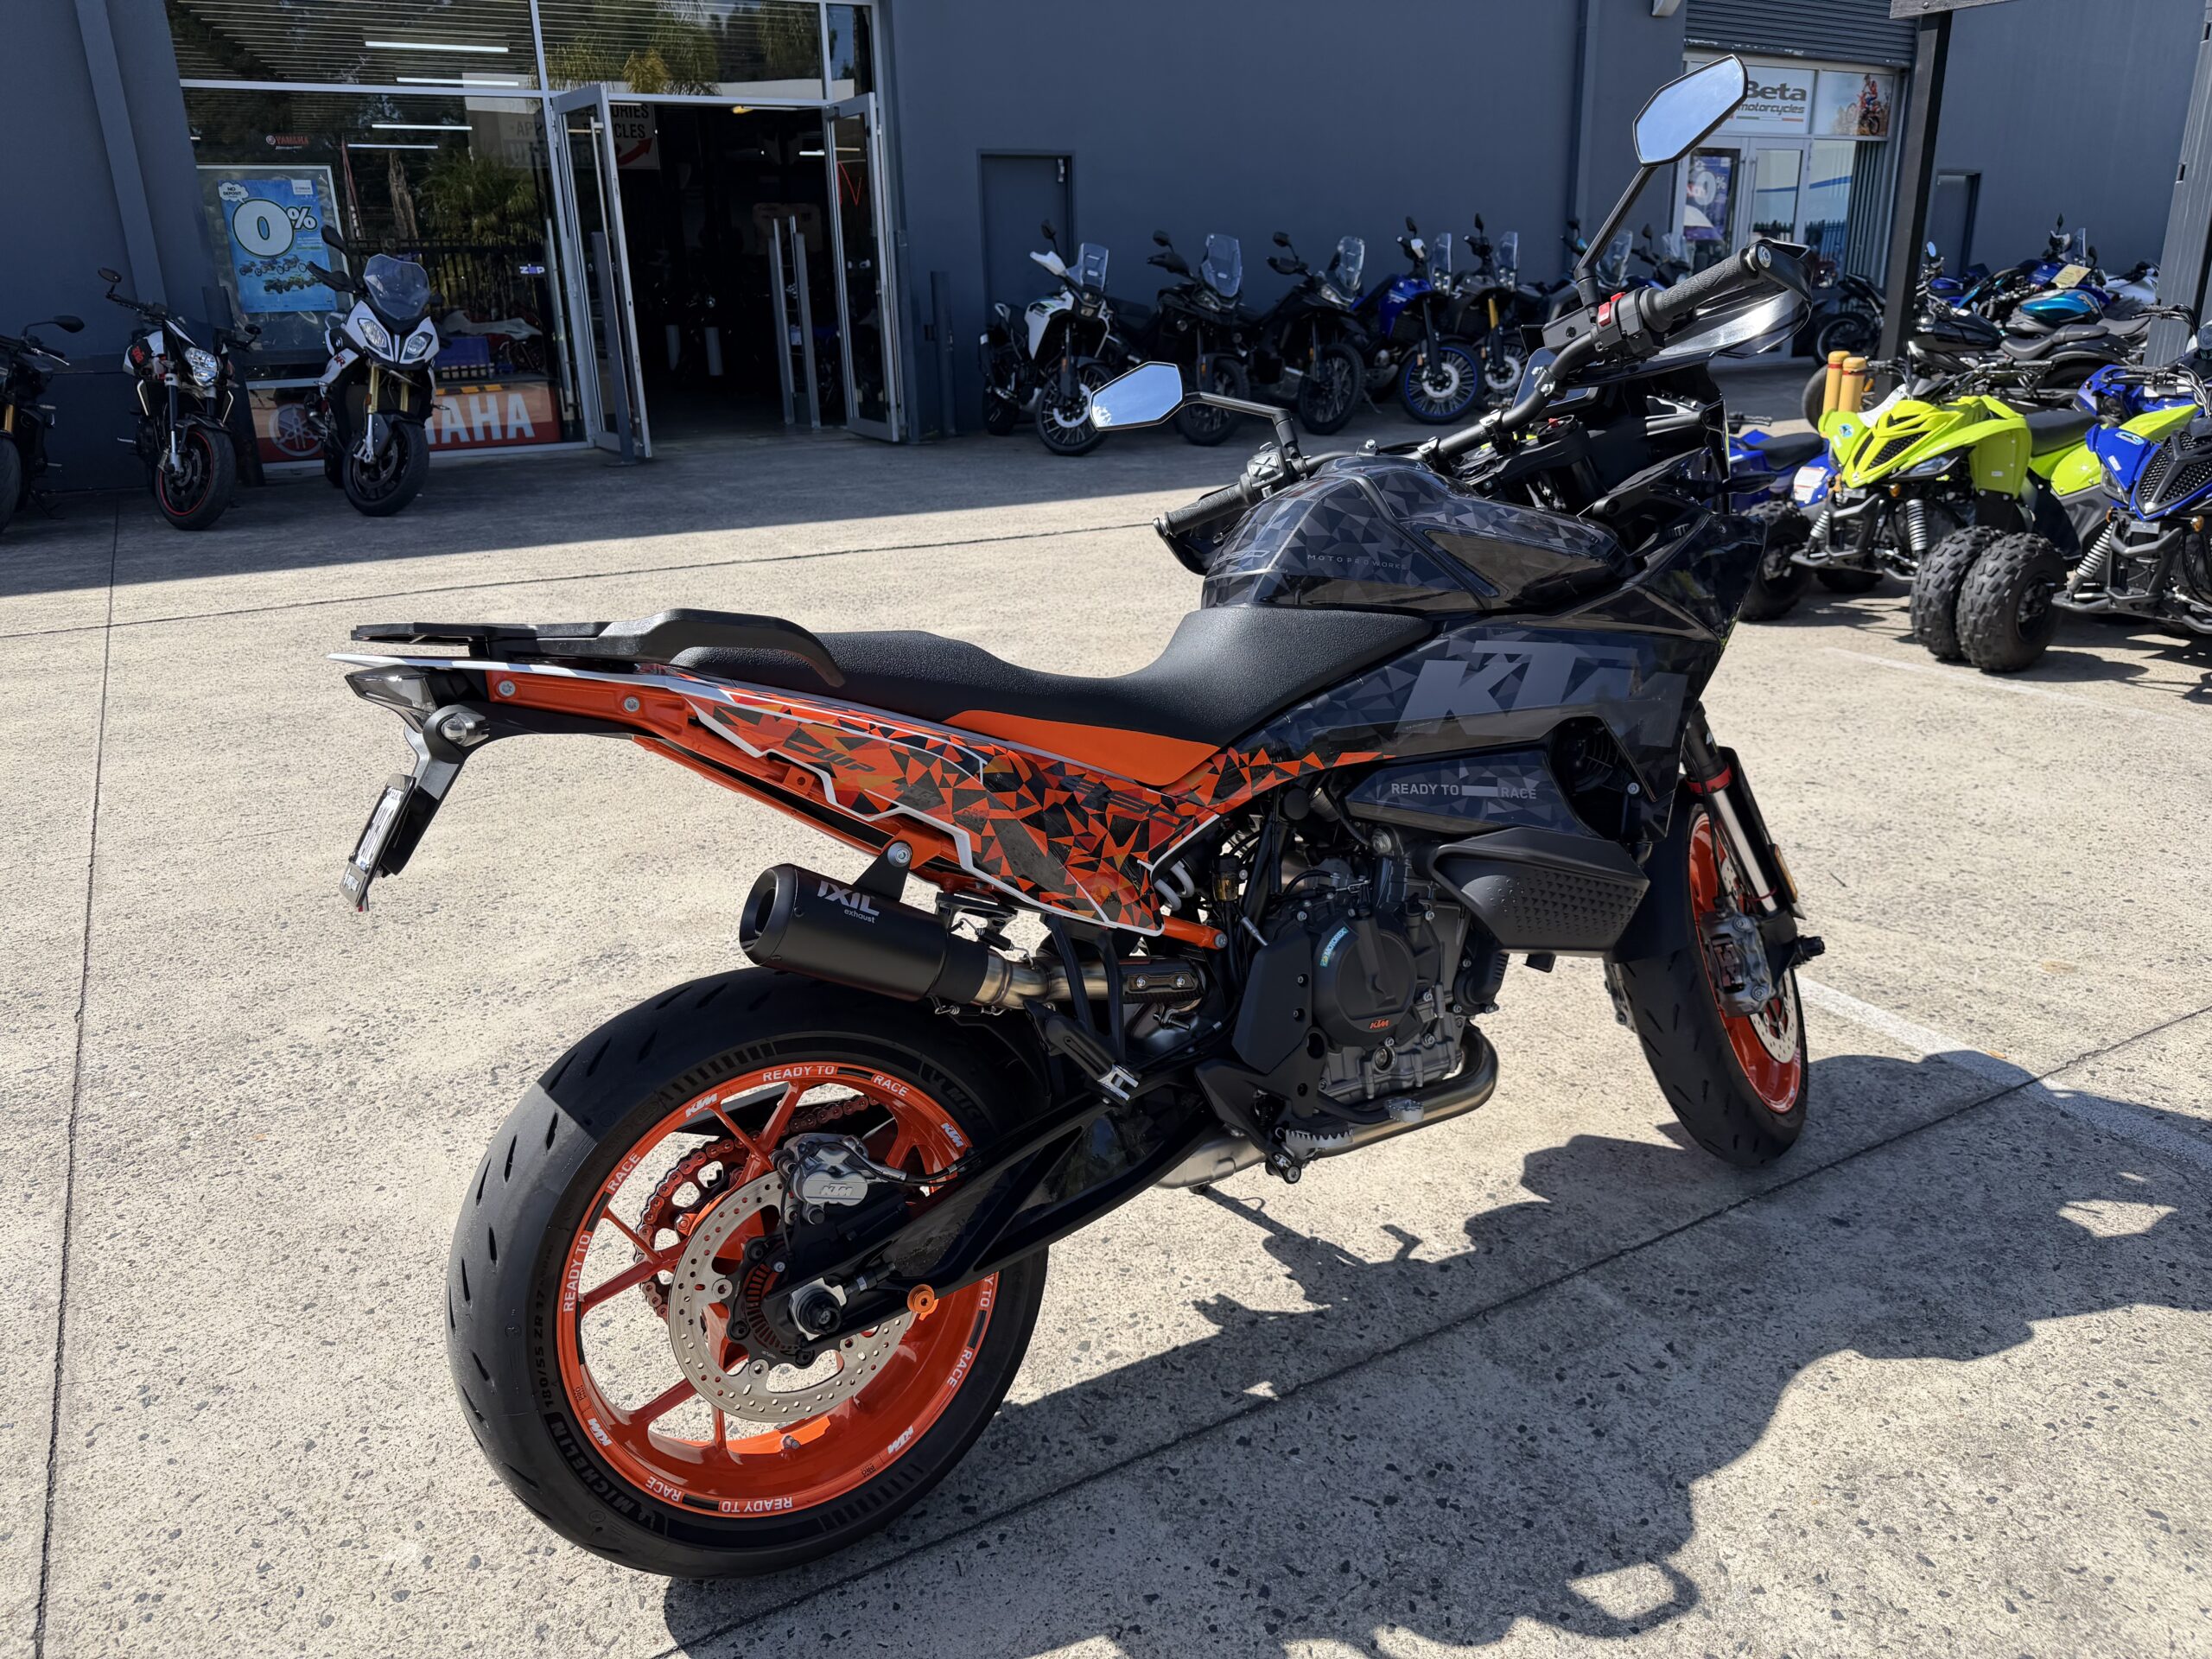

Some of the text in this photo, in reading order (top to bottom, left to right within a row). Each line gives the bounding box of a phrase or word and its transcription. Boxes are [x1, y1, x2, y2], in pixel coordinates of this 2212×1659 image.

[1746, 80, 1807, 101] Beta
[1737, 102, 1805, 115] motorcycles
[1307, 554, 1343, 563] MOTO
[1395, 640, 1688, 747] KTM
[1391, 783, 1537, 799] READY TO RACE
[817, 880, 880, 916] IXIL
[844, 908, 875, 924] exhaust
[1325, 926, 1348, 957] MOTOREX
[1370, 1019, 1389, 1030] KTM
[763, 1065, 910, 1096] READY TO RACE
[685, 1093, 718, 1117] KTM
[940, 1122, 964, 1147] KTM
[821, 1183, 854, 1197] KTM
[563, 1153, 641, 1313] READY TO RACE
[980, 1289, 992, 1307] TO
[534, 1314, 543, 1338] ZR
[535, 1345, 554, 1408] 180/55
[947, 1349, 973, 1388] RACE
[587, 1418, 613, 1446] KTM
[887, 1425, 914, 1454] KTM
[550, 1421, 635, 1514] MICHELIN
[645, 1476, 793, 1513] READY TO RACE
